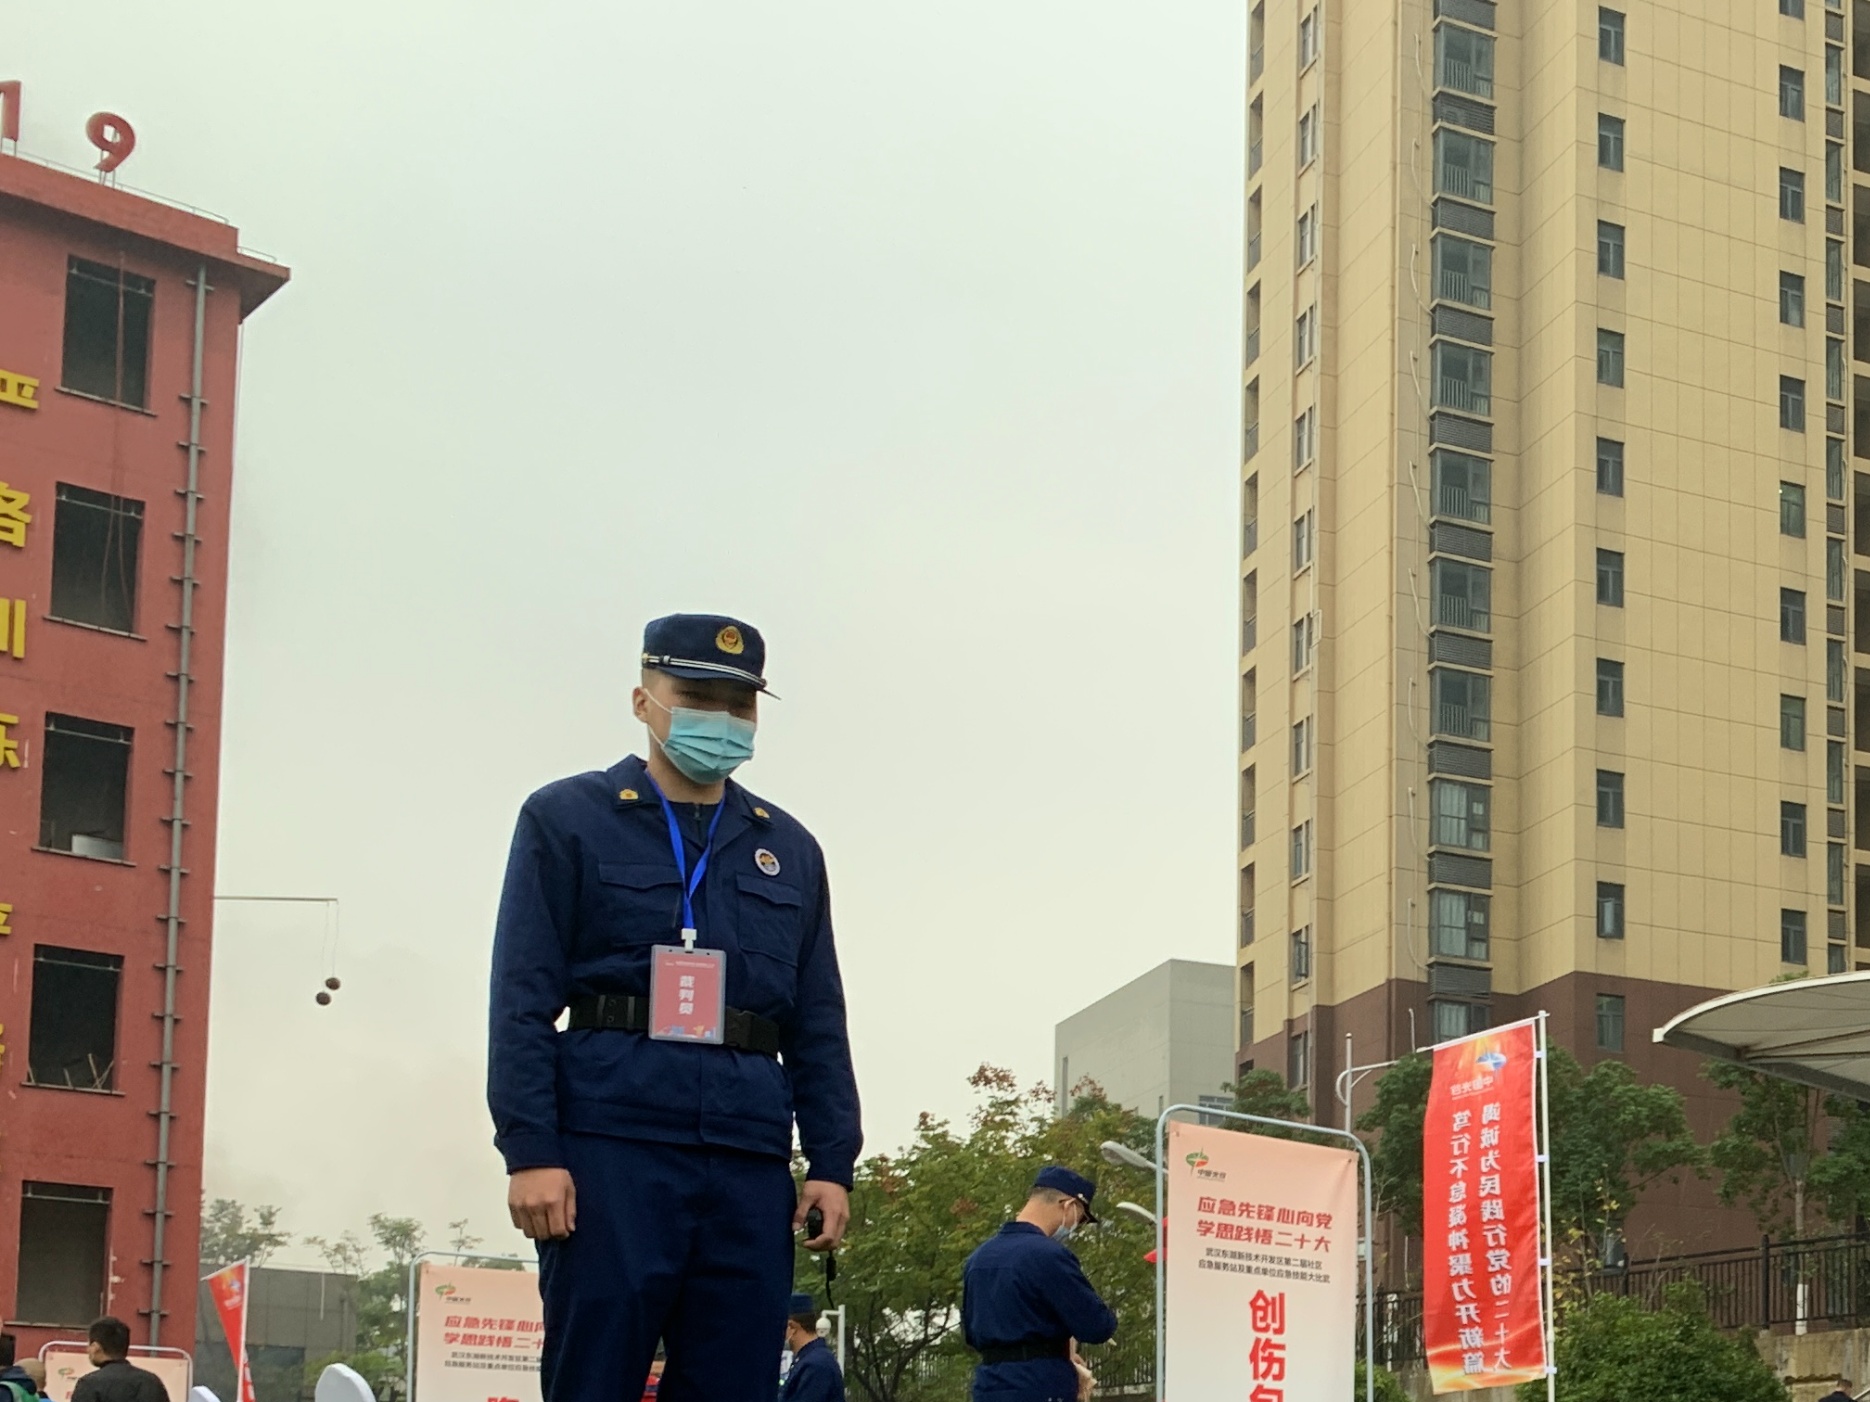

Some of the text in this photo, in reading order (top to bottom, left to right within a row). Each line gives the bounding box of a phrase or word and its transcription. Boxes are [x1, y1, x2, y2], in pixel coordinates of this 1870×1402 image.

[1197, 1196, 1333, 1230] 应急先锋心向党
[1196, 1219, 1332, 1253] 学思践悟二十大
